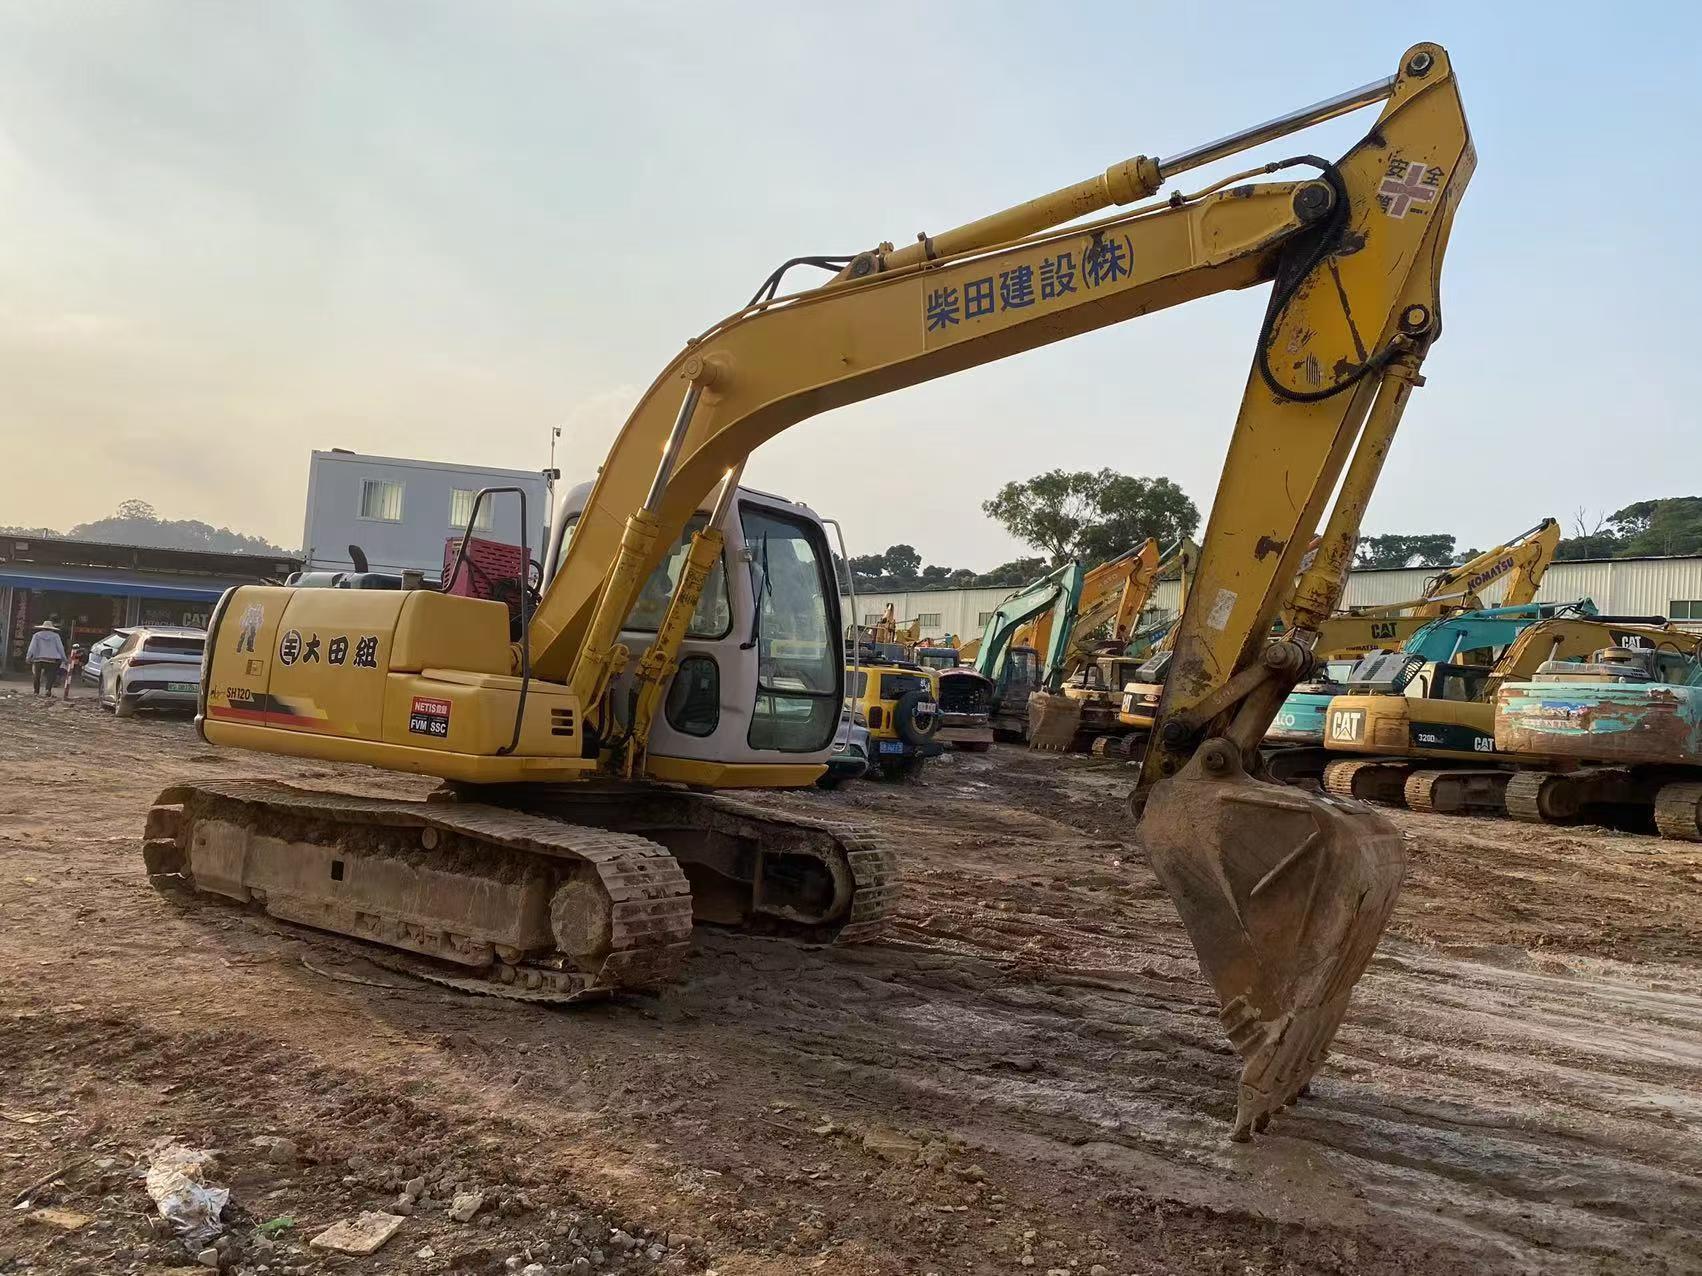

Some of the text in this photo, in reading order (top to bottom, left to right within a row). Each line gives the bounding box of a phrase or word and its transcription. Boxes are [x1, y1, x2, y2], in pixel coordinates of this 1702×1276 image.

[1467, 556, 1515, 592] KOMATSU
[182, 613, 208, 628] CAT
[1371, 622, 1397, 639] CAT
[1621, 636, 1641, 649] CAT
[302, 632, 379, 669] 大田組
[226, 686, 251, 700] SH120
[410, 719, 428, 731] FVM
[430, 722, 447, 734] SSC
[1332, 711, 1361, 741] CAT
[1474, 736, 1495, 752] CAT
